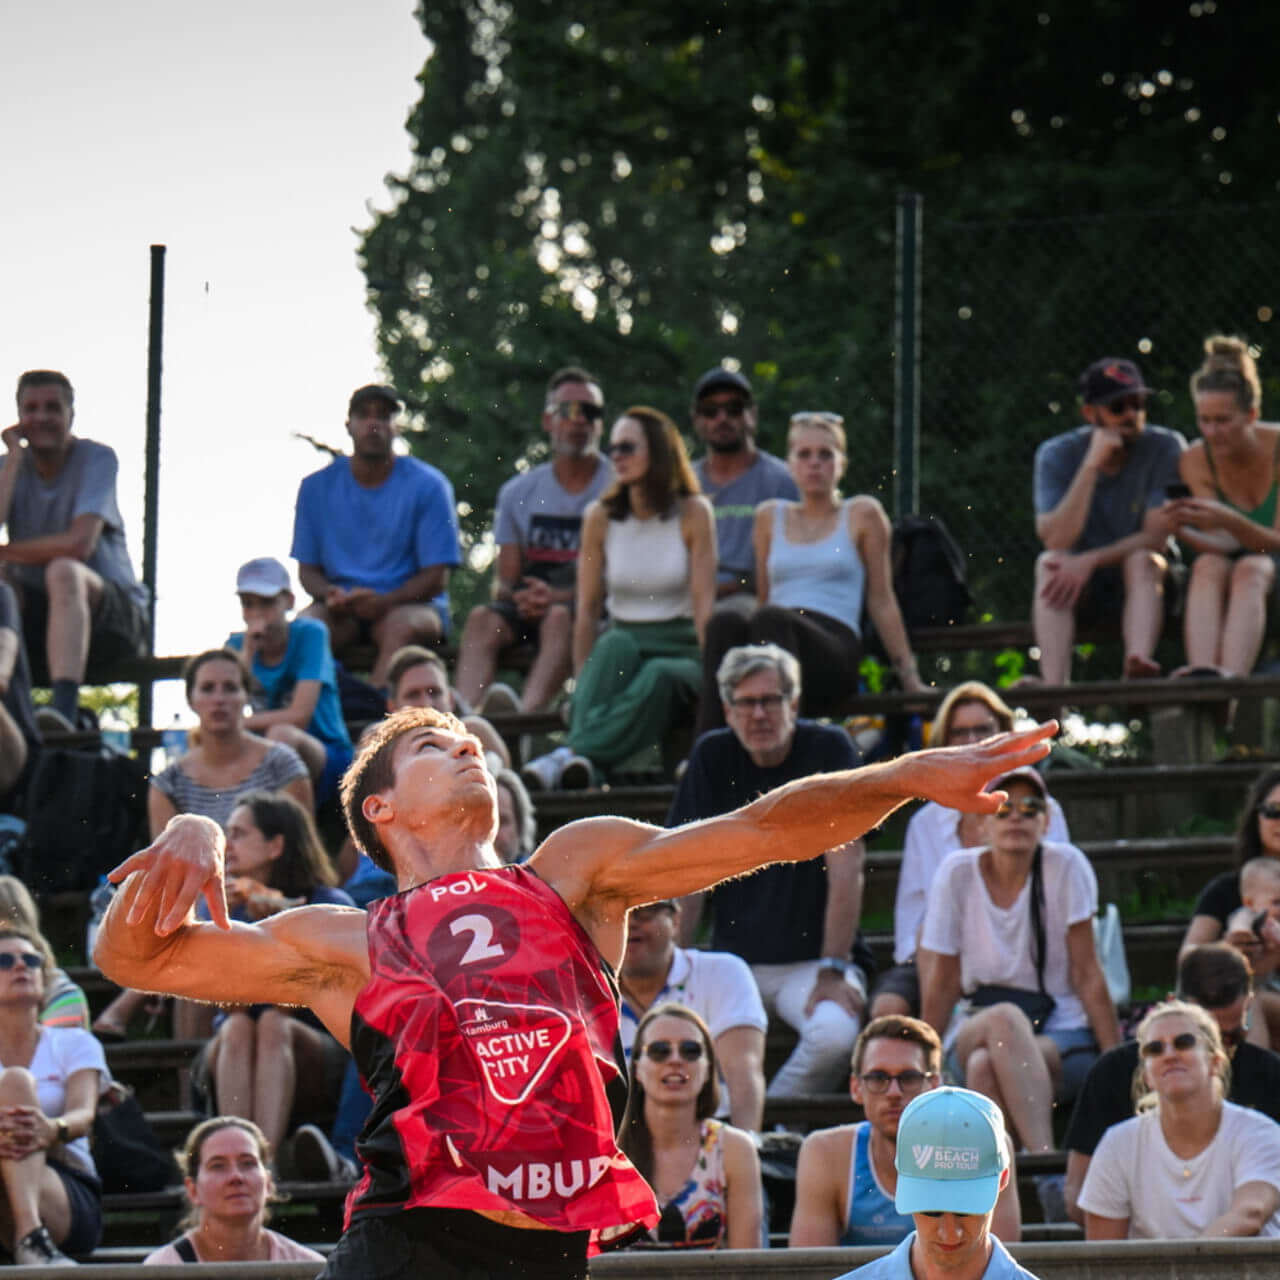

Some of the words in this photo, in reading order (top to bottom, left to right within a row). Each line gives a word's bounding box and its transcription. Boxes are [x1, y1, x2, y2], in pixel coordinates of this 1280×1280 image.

[431, 873, 487, 902] POL
[449, 914, 505, 967] 2
[476, 1029, 551, 1057] ACTIVE
[935, 1151, 979, 1162] BEACH
